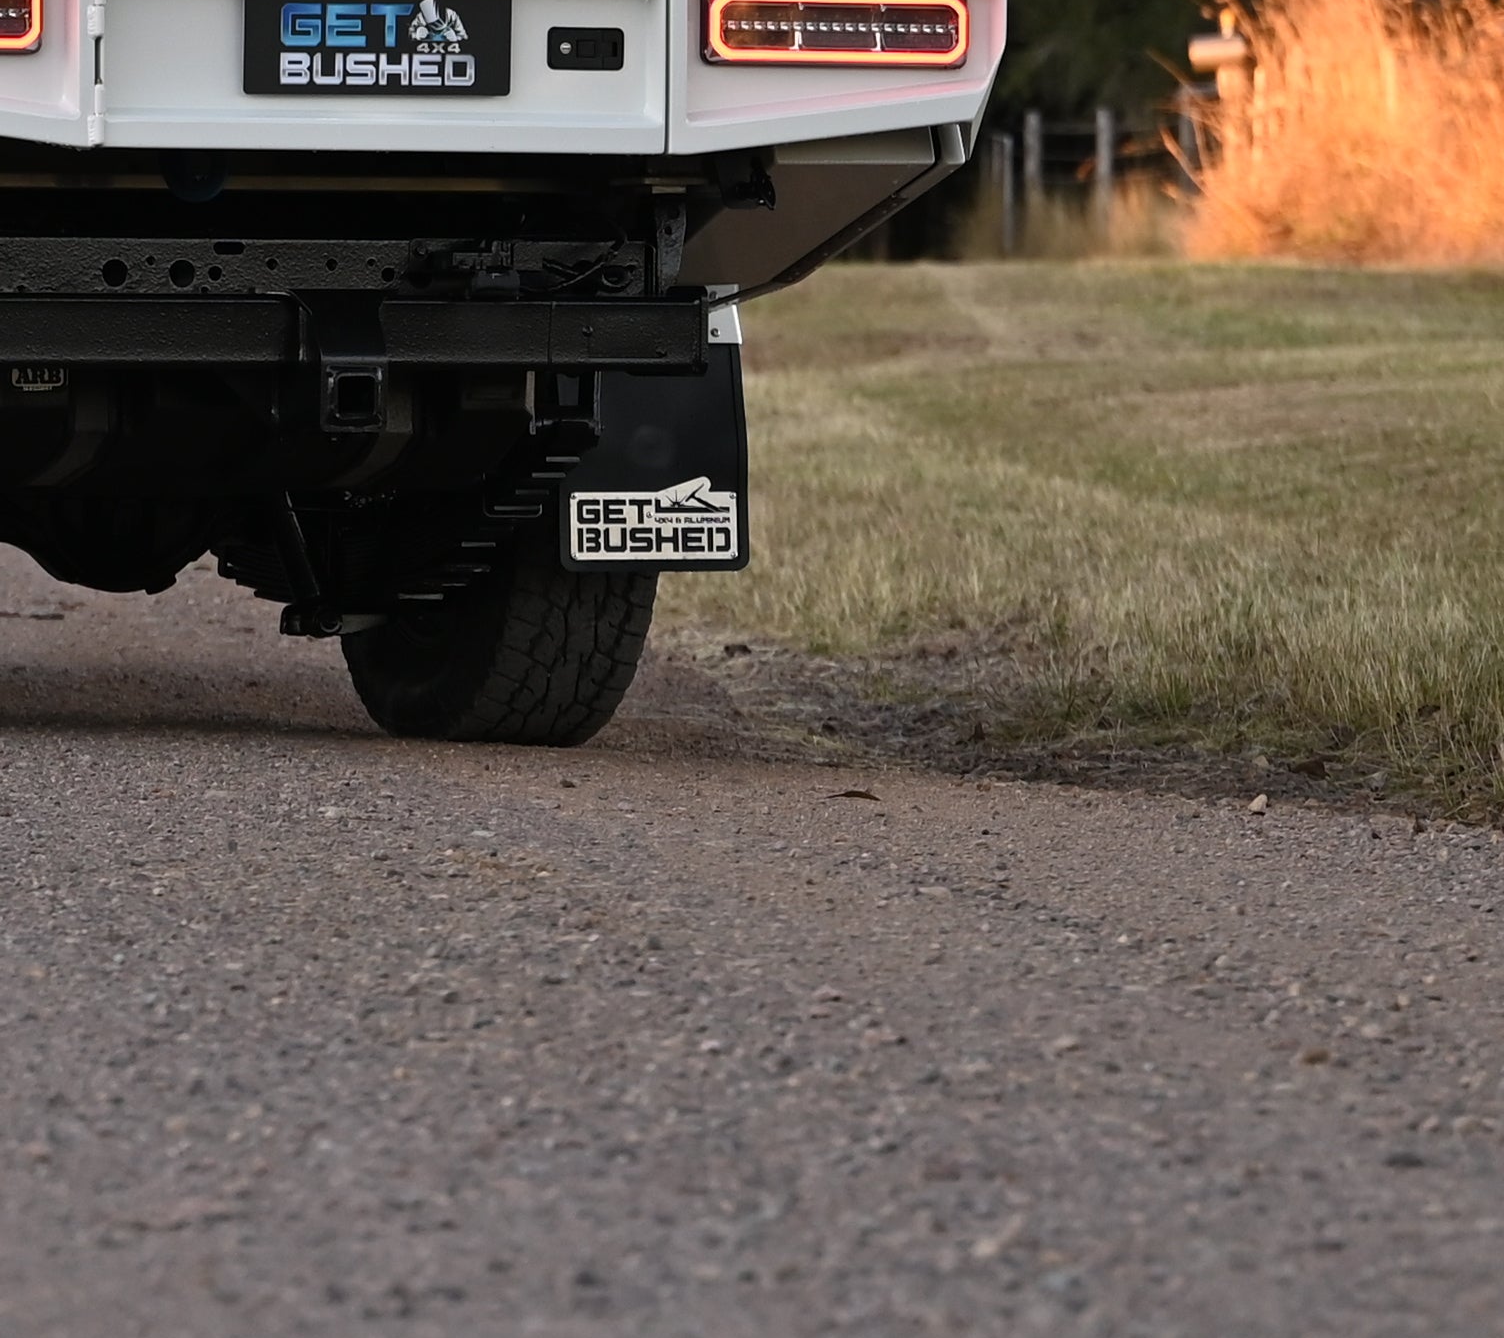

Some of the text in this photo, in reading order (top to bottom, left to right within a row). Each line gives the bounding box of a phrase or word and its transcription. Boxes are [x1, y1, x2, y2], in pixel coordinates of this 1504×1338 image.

[280, 2, 417, 48] GET
[279, 51, 477, 88] BUSHED
[576, 499, 653, 525] GET
[577, 527, 732, 553] BUSHED
